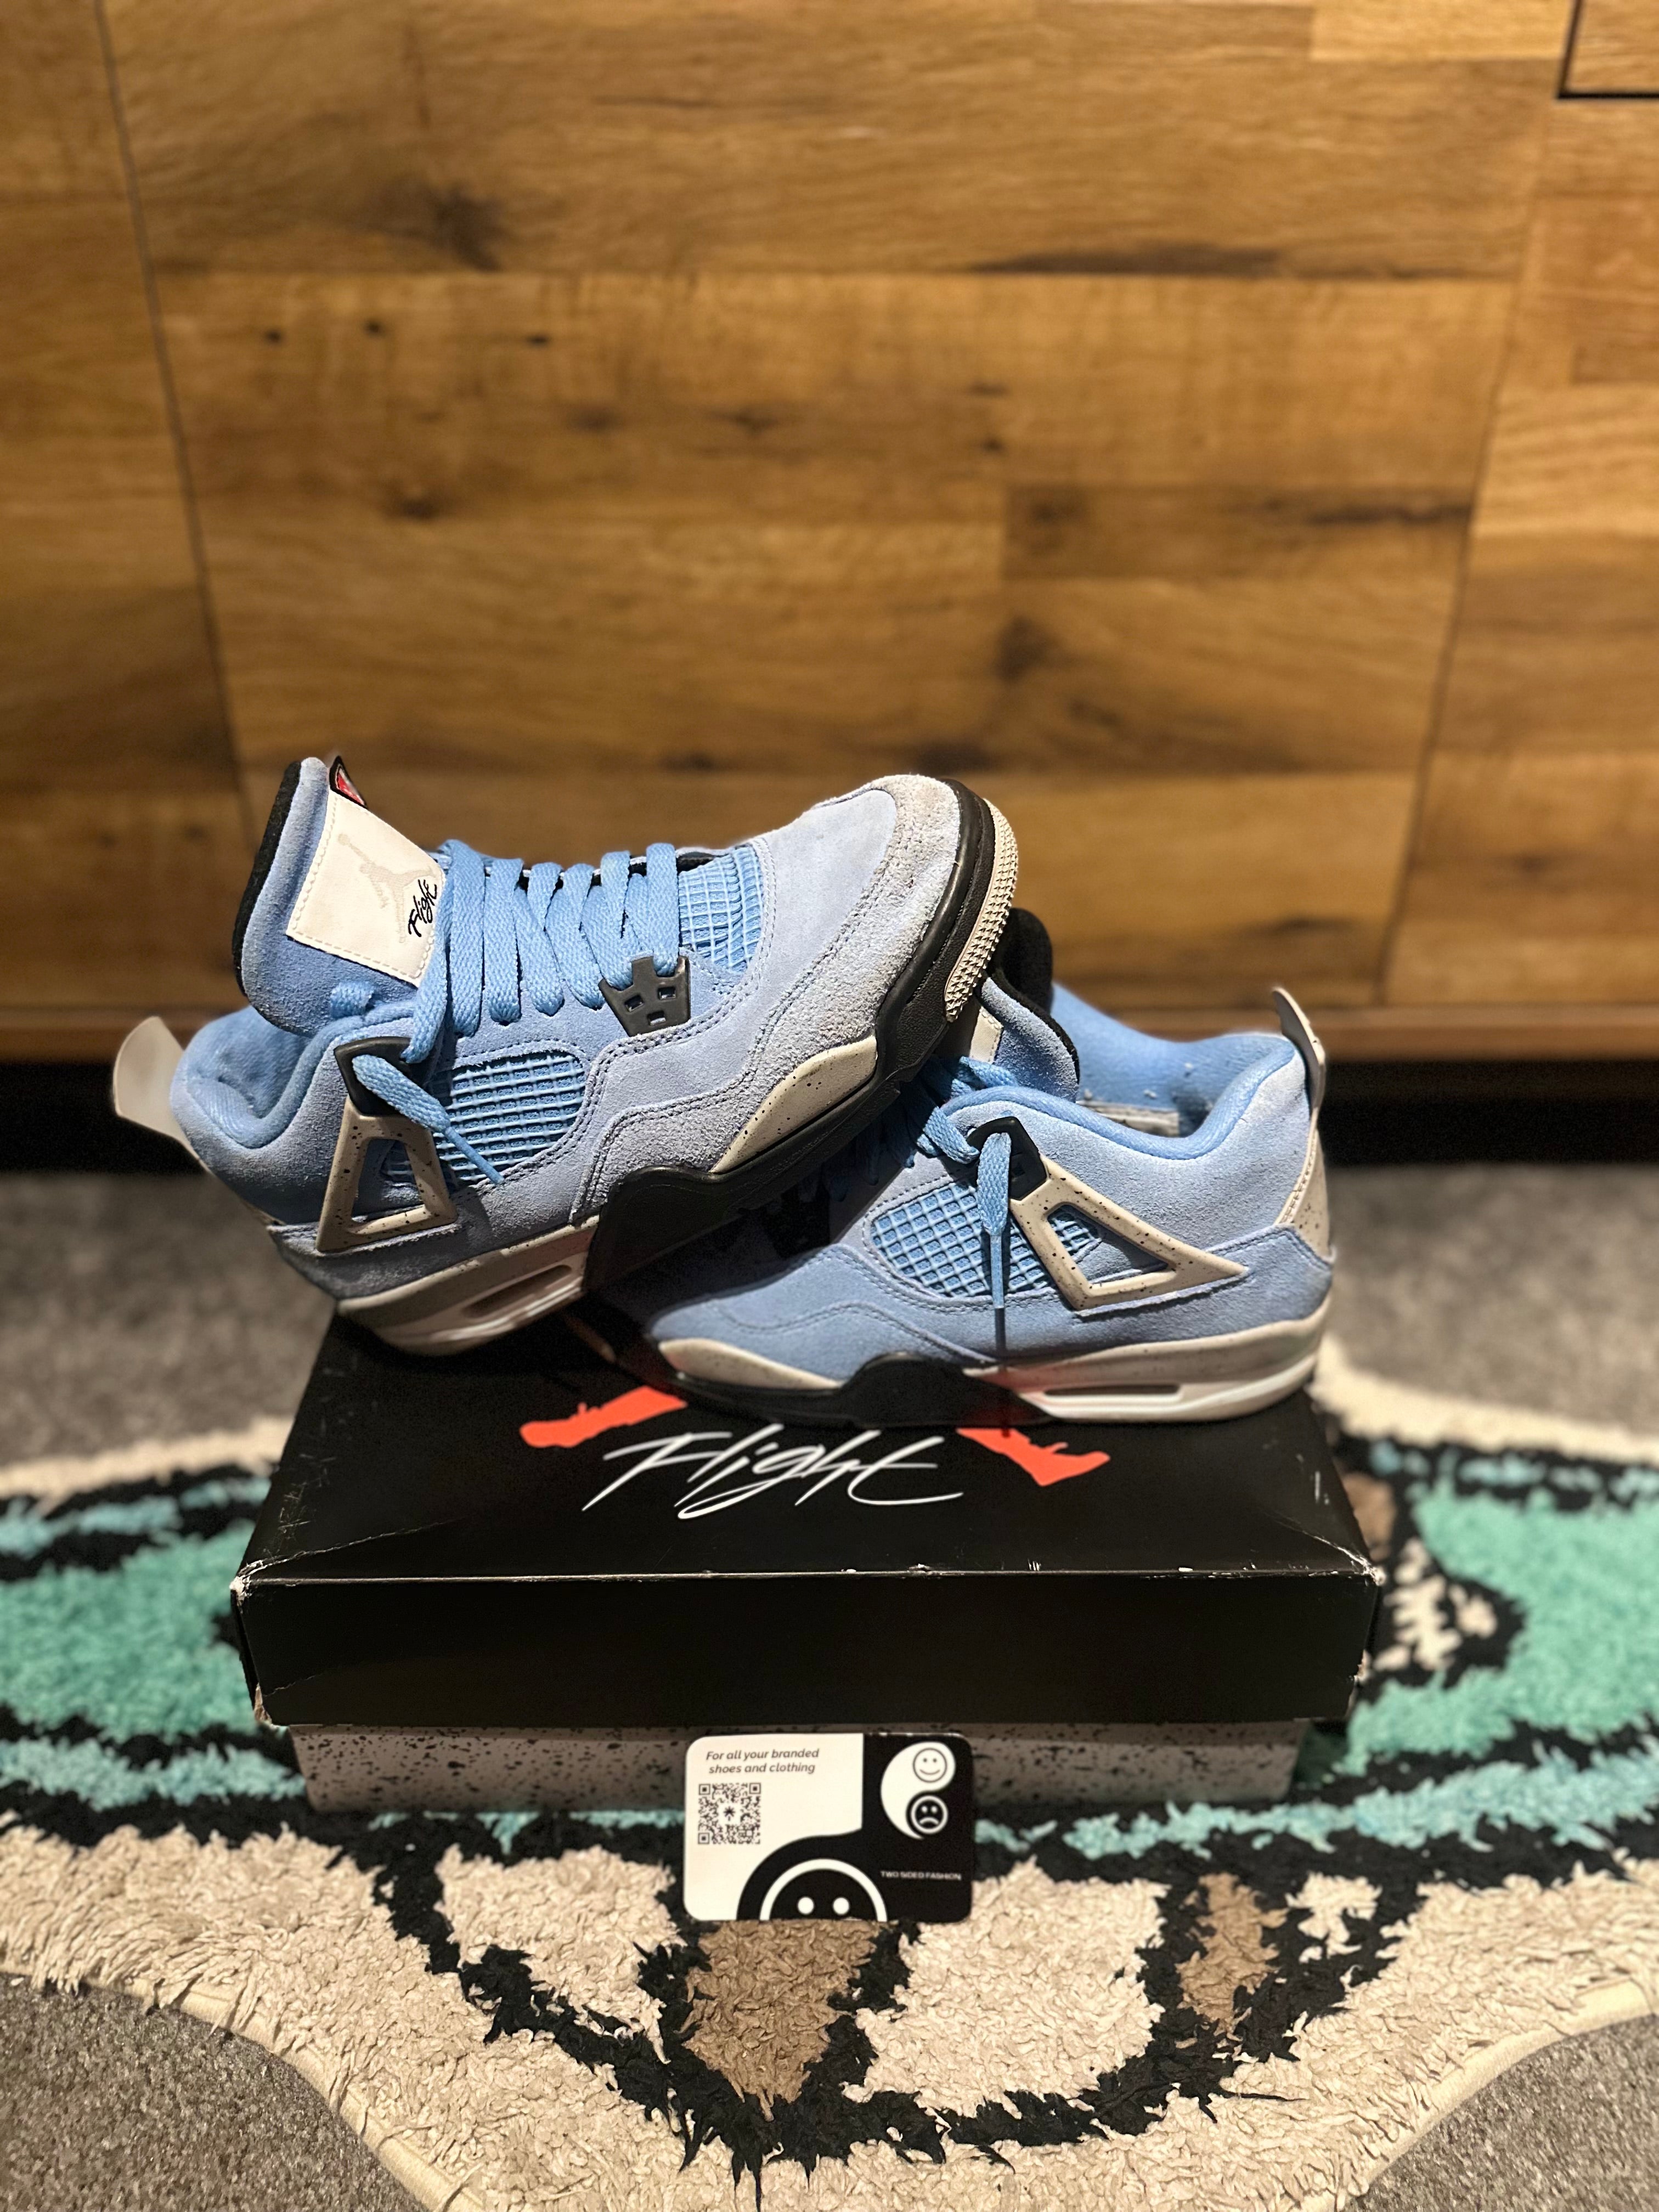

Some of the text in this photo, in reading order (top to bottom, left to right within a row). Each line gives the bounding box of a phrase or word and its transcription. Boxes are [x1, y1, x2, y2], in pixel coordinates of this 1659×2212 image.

[408, 879, 437, 937] Flight
[582, 1423, 963, 1519] Flight
[706, 1748, 820, 1761] For all your branded
[709, 1762, 816, 1774] shoes and clothing
